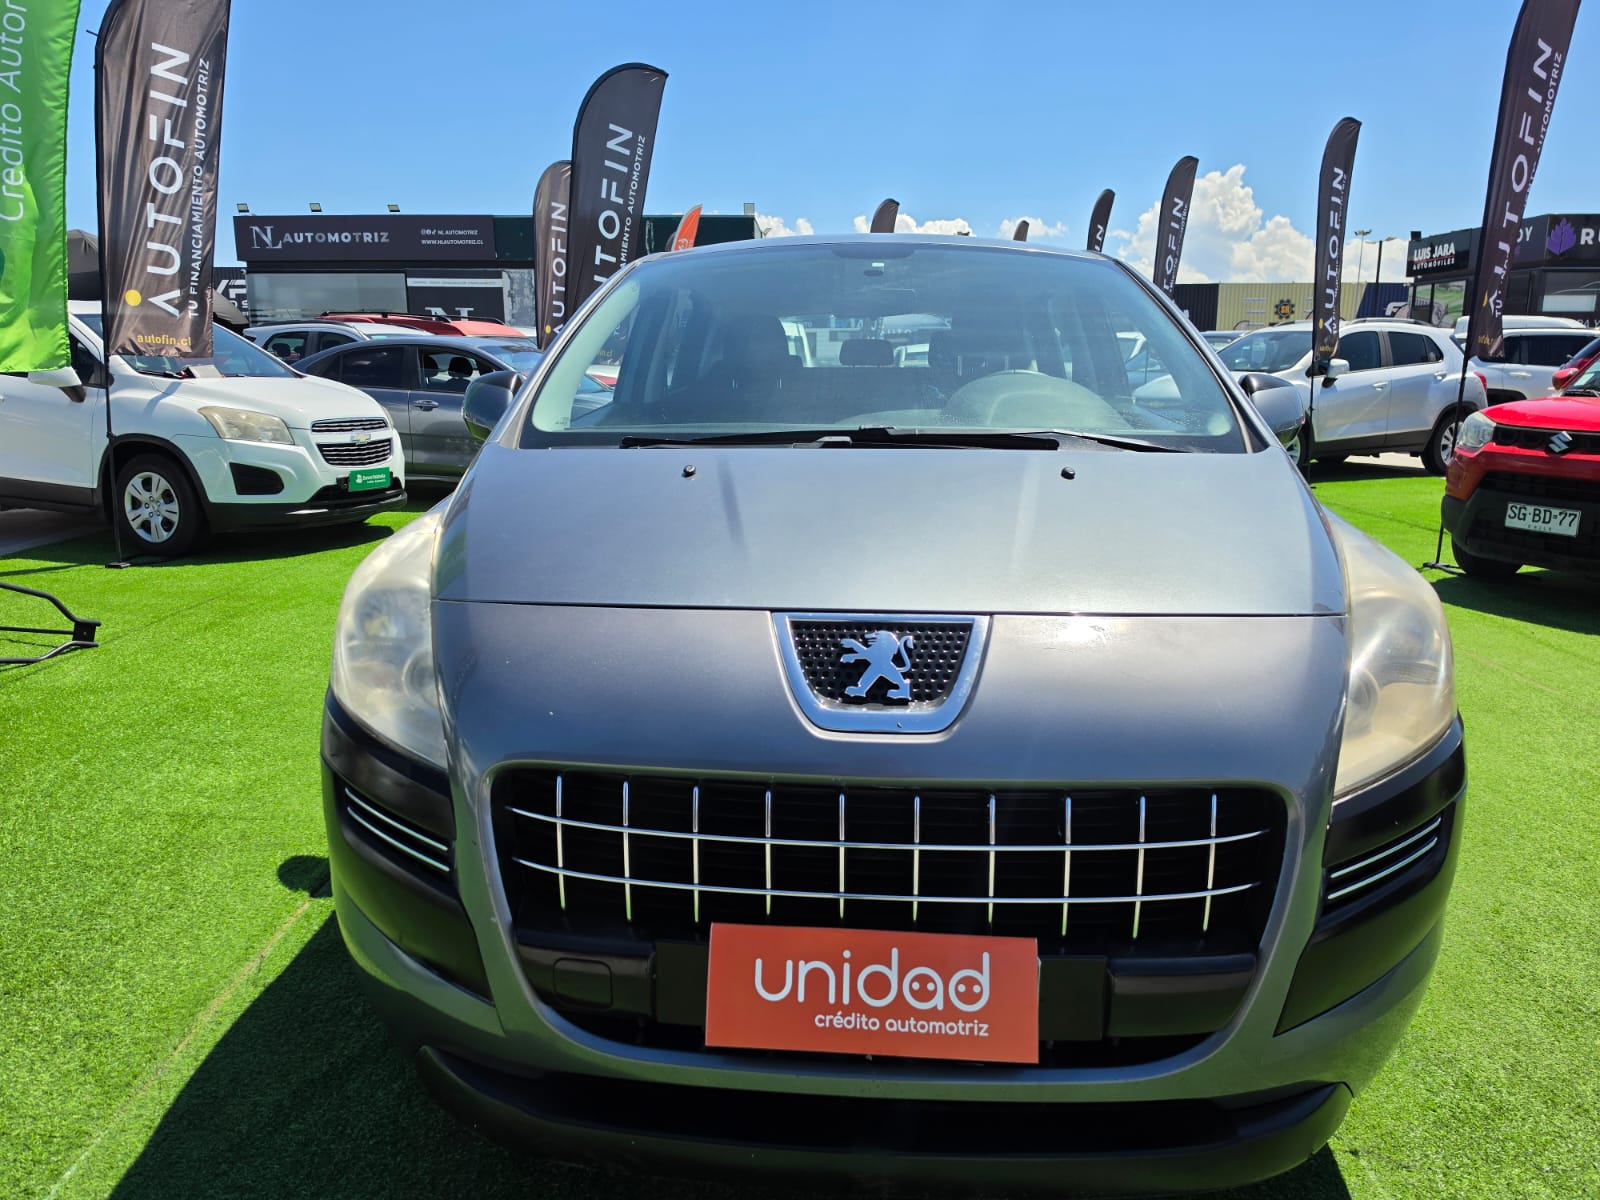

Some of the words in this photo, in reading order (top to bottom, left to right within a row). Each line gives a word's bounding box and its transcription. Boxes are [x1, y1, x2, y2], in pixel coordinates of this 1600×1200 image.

[194, 58, 210, 160] AUTOMOTRIZ
[147, 42, 190, 317] AUTOFIN
[594, 123, 633, 284] TOFIN
[626, 135, 646, 214] AUTOMOTRIZ
[189, 165, 203, 296] FINANCIAMIENTO
[249, 226, 282, 249] NL
[282, 232, 390, 243] AUTOMOTRIZ
[551, 201, 567, 334] AUTOFIN
[1163, 197, 1184, 290] TOFIN
[1324, 167, 1344, 334] AUTOFIN
[1413, 247, 1431, 261] LUIS
[1432, 242, 1456, 258] JARA
[137, 334, 192, 346] autofin.cl
[188, 300, 199, 319] TU
[755, 947, 990, 1012] unidad
[814, 1010, 880, 1031] crédito
[885, 1018, 989, 1037] automotriz
